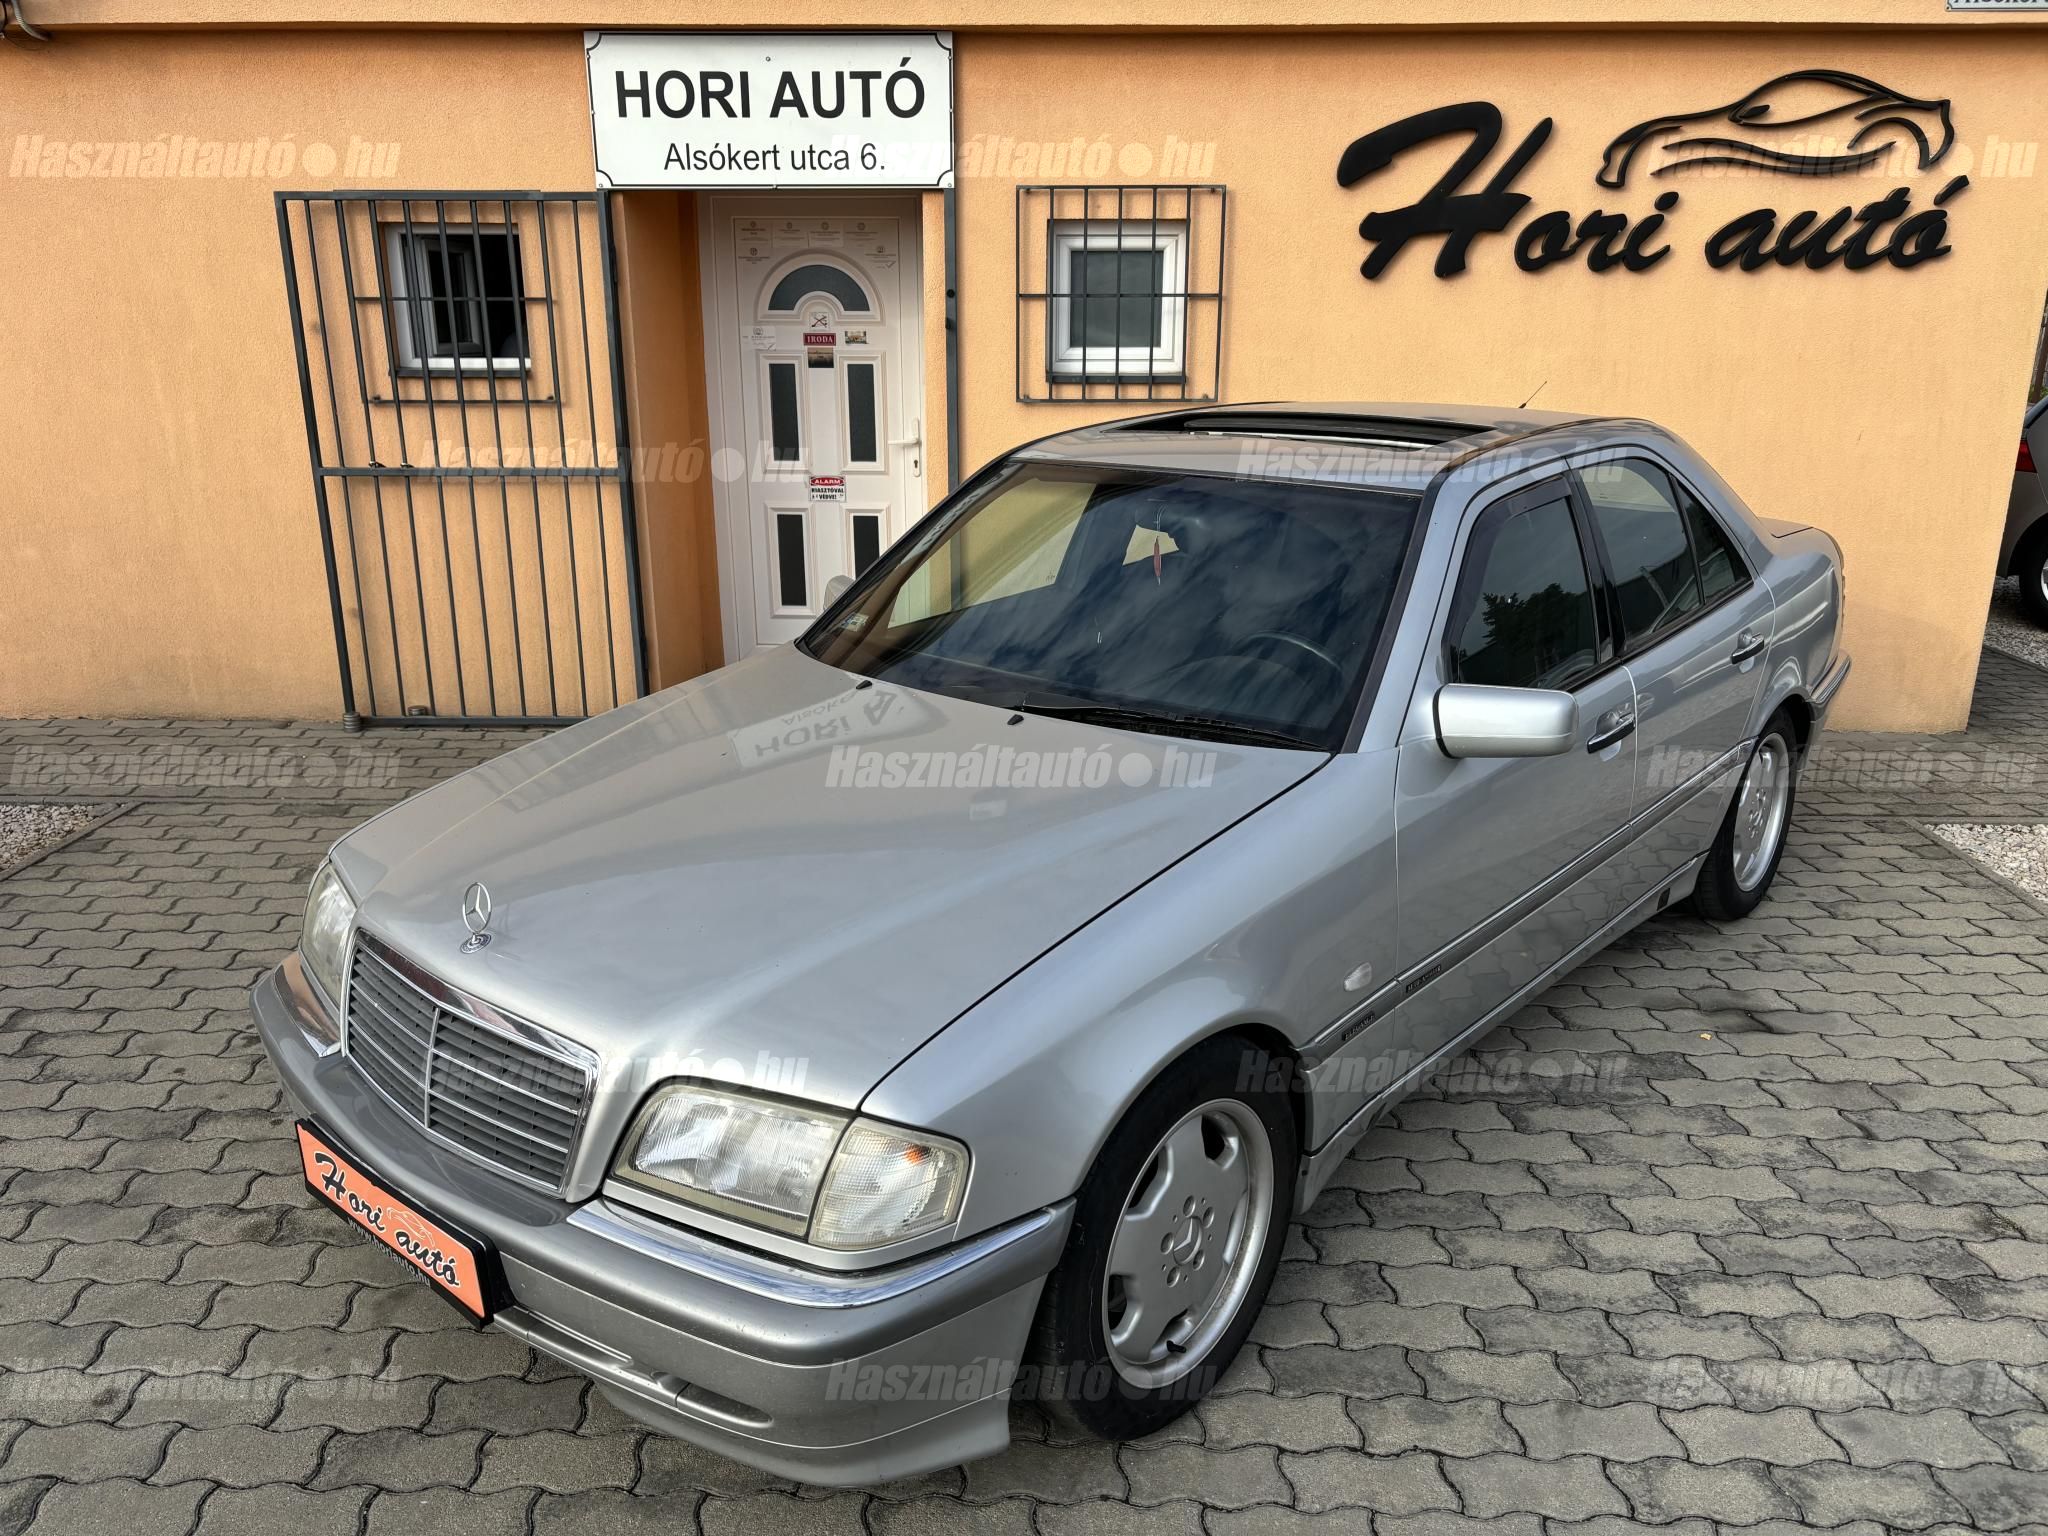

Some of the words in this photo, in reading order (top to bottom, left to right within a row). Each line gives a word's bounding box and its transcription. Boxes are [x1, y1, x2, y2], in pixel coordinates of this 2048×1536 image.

[615, 70, 751, 118] HORI
[769, 57, 925, 119] AUTÓ
[664, 143, 780, 171] Alsókert
[790, 144, 850, 170] utca
[860, 143, 886, 170] 6.
[1336, 101, 1680, 280] Hori
[1704, 175, 1970, 272] autó
[807, 335, 833, 343] IRODA
[314, 1152, 386, 1231] Hori
[395, 1230, 461, 1288] autó
